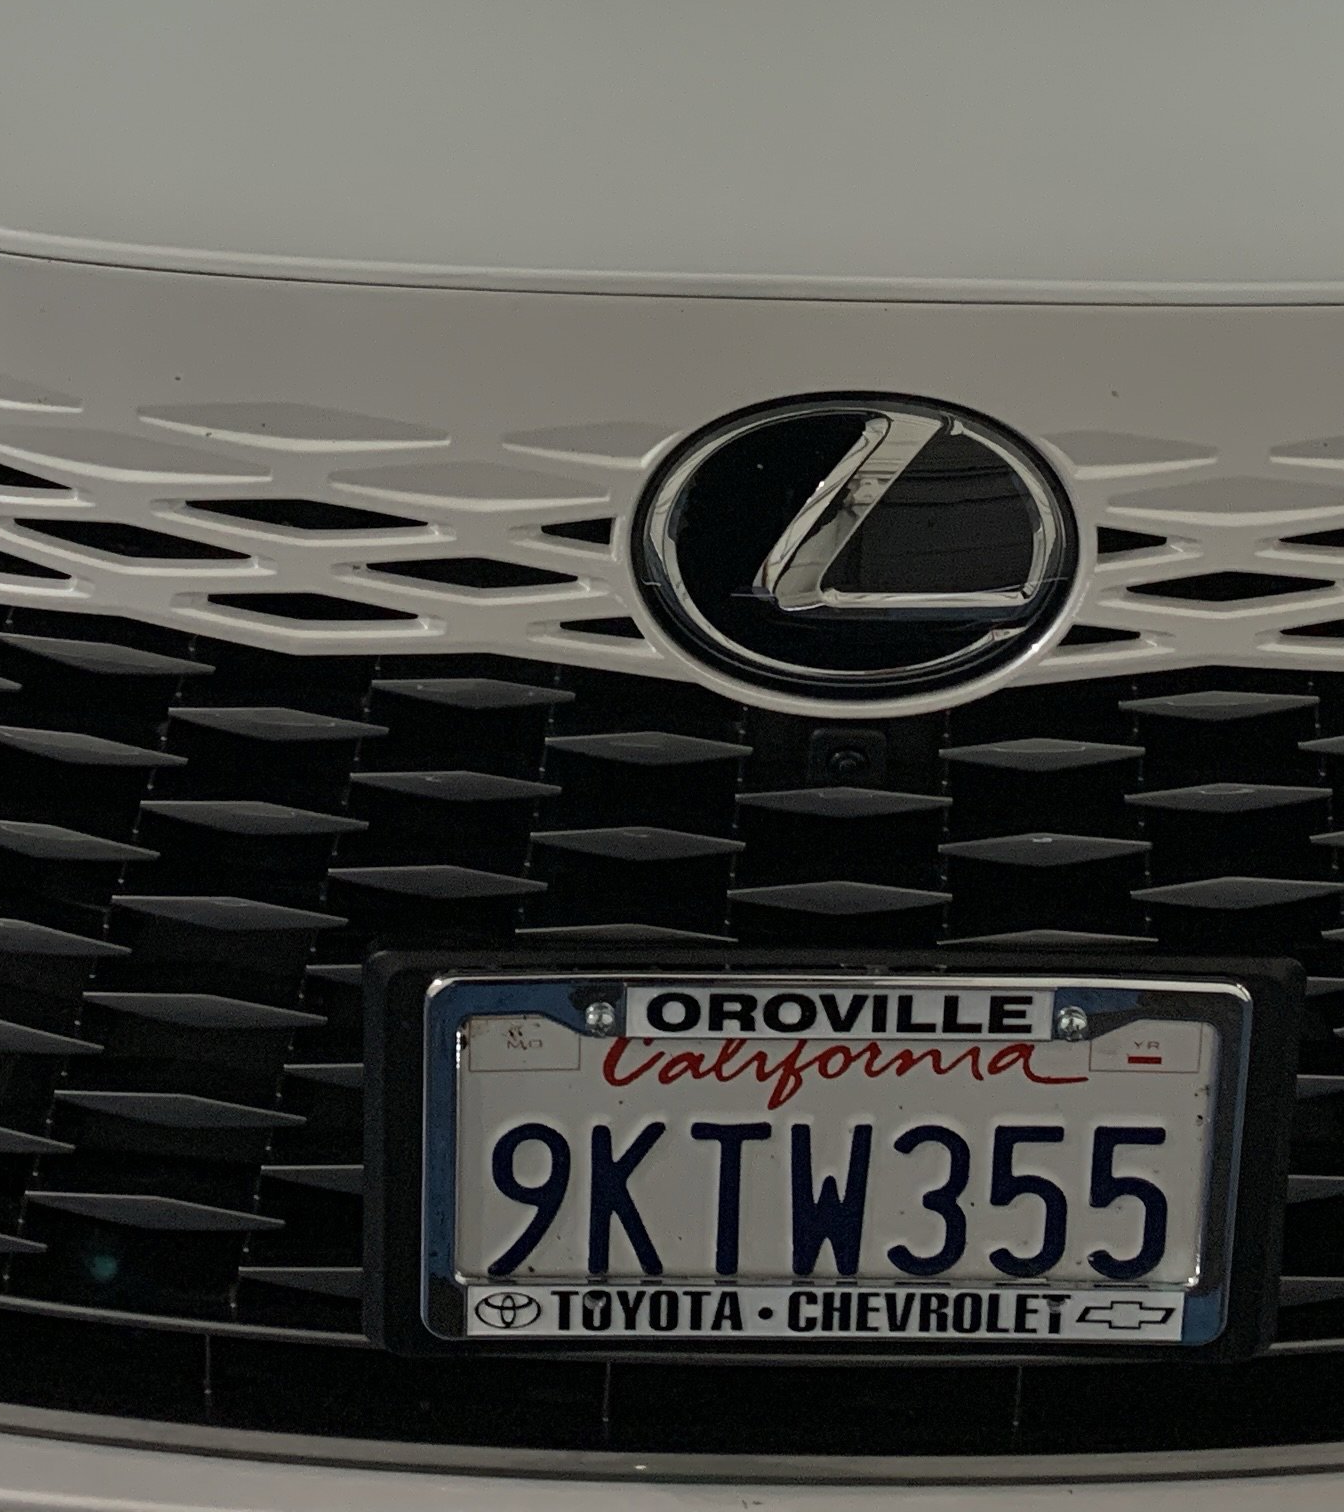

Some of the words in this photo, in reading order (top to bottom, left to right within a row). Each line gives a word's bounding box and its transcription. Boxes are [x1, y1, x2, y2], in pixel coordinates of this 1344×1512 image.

[646, 992, 1033, 1033] OROVILLE
[1133, 1039, 1161, 1051] YR
[604, 1038, 1089, 1110] California
[488, 1121, 1167, 1279] 9KTW355
[552, 1290, 744, 1334] TOYOTA
[787, 1292, 1072, 1335] CHEVROLET
